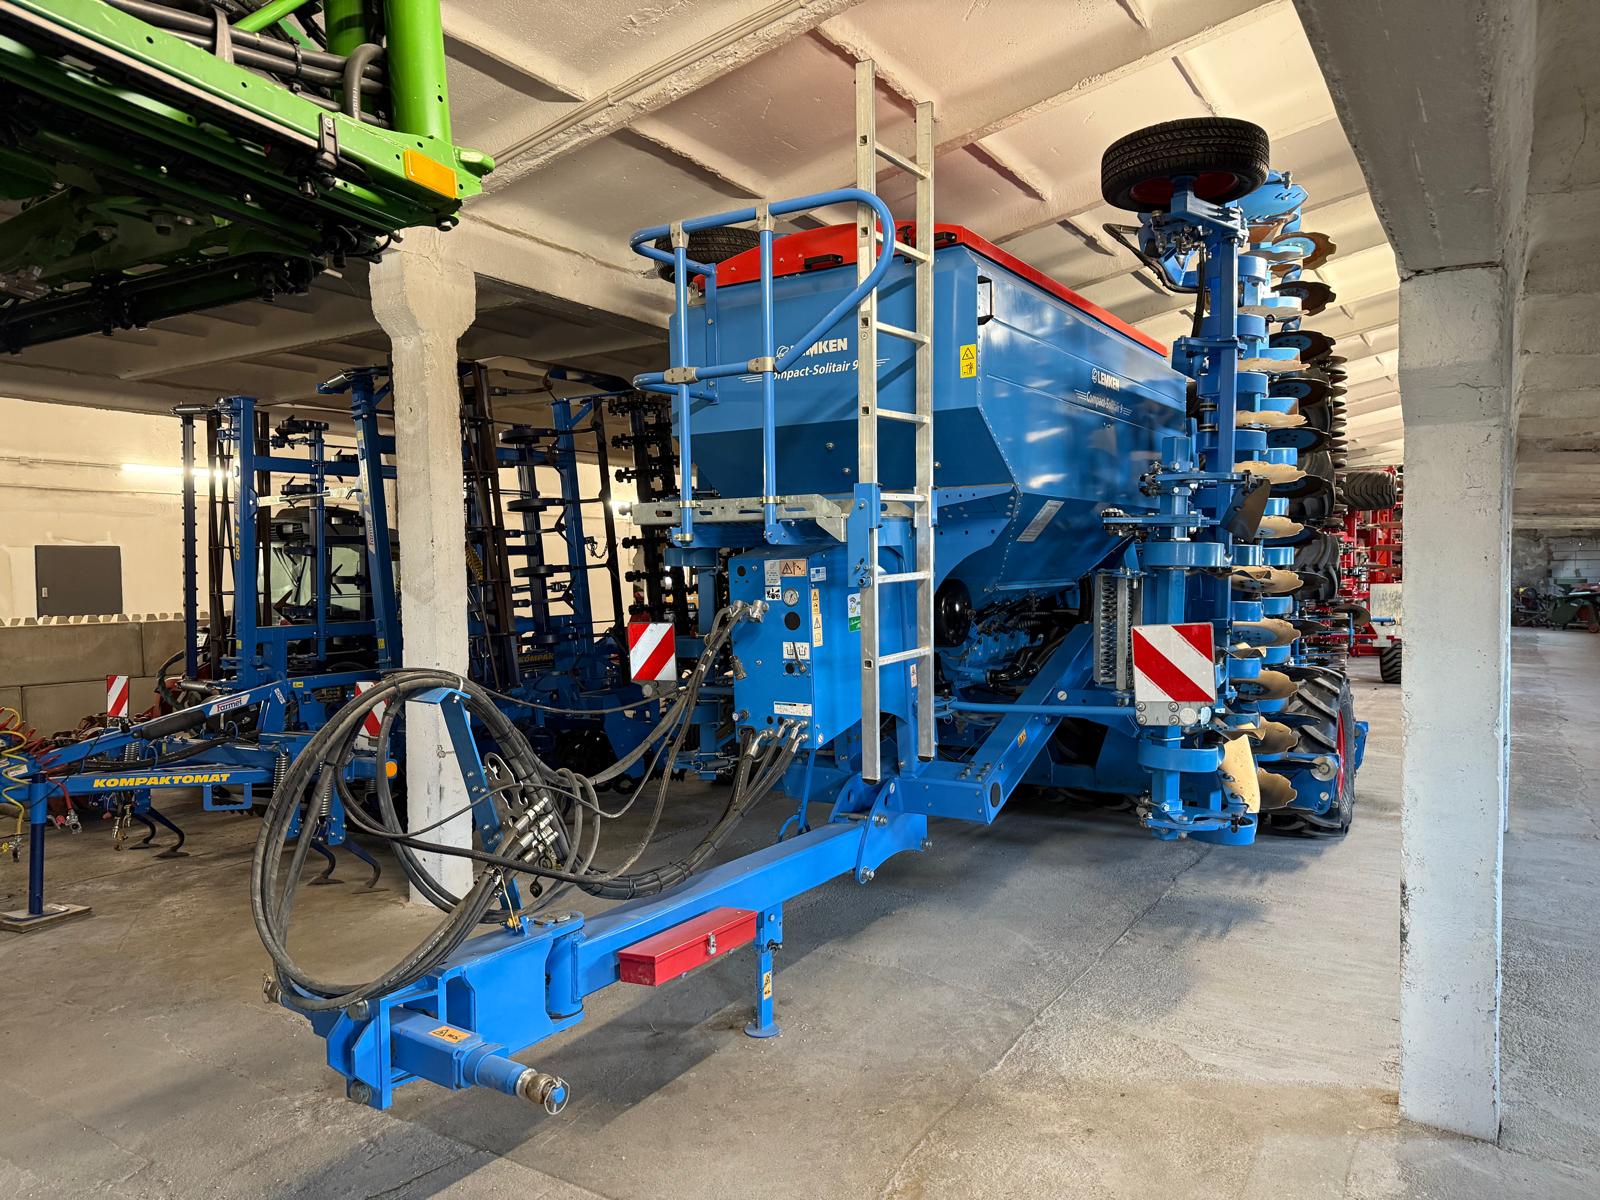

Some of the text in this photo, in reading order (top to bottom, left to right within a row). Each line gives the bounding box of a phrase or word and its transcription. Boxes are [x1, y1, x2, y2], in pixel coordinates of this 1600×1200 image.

[789, 338, 848, 357] MKEN
[774, 360, 850, 381] ompact-Solitair
[1097, 370, 1120, 391] LEMKEN
[216, 698, 243, 713] Farmet
[93, 773, 231, 788] KOMPAKTOMAT
